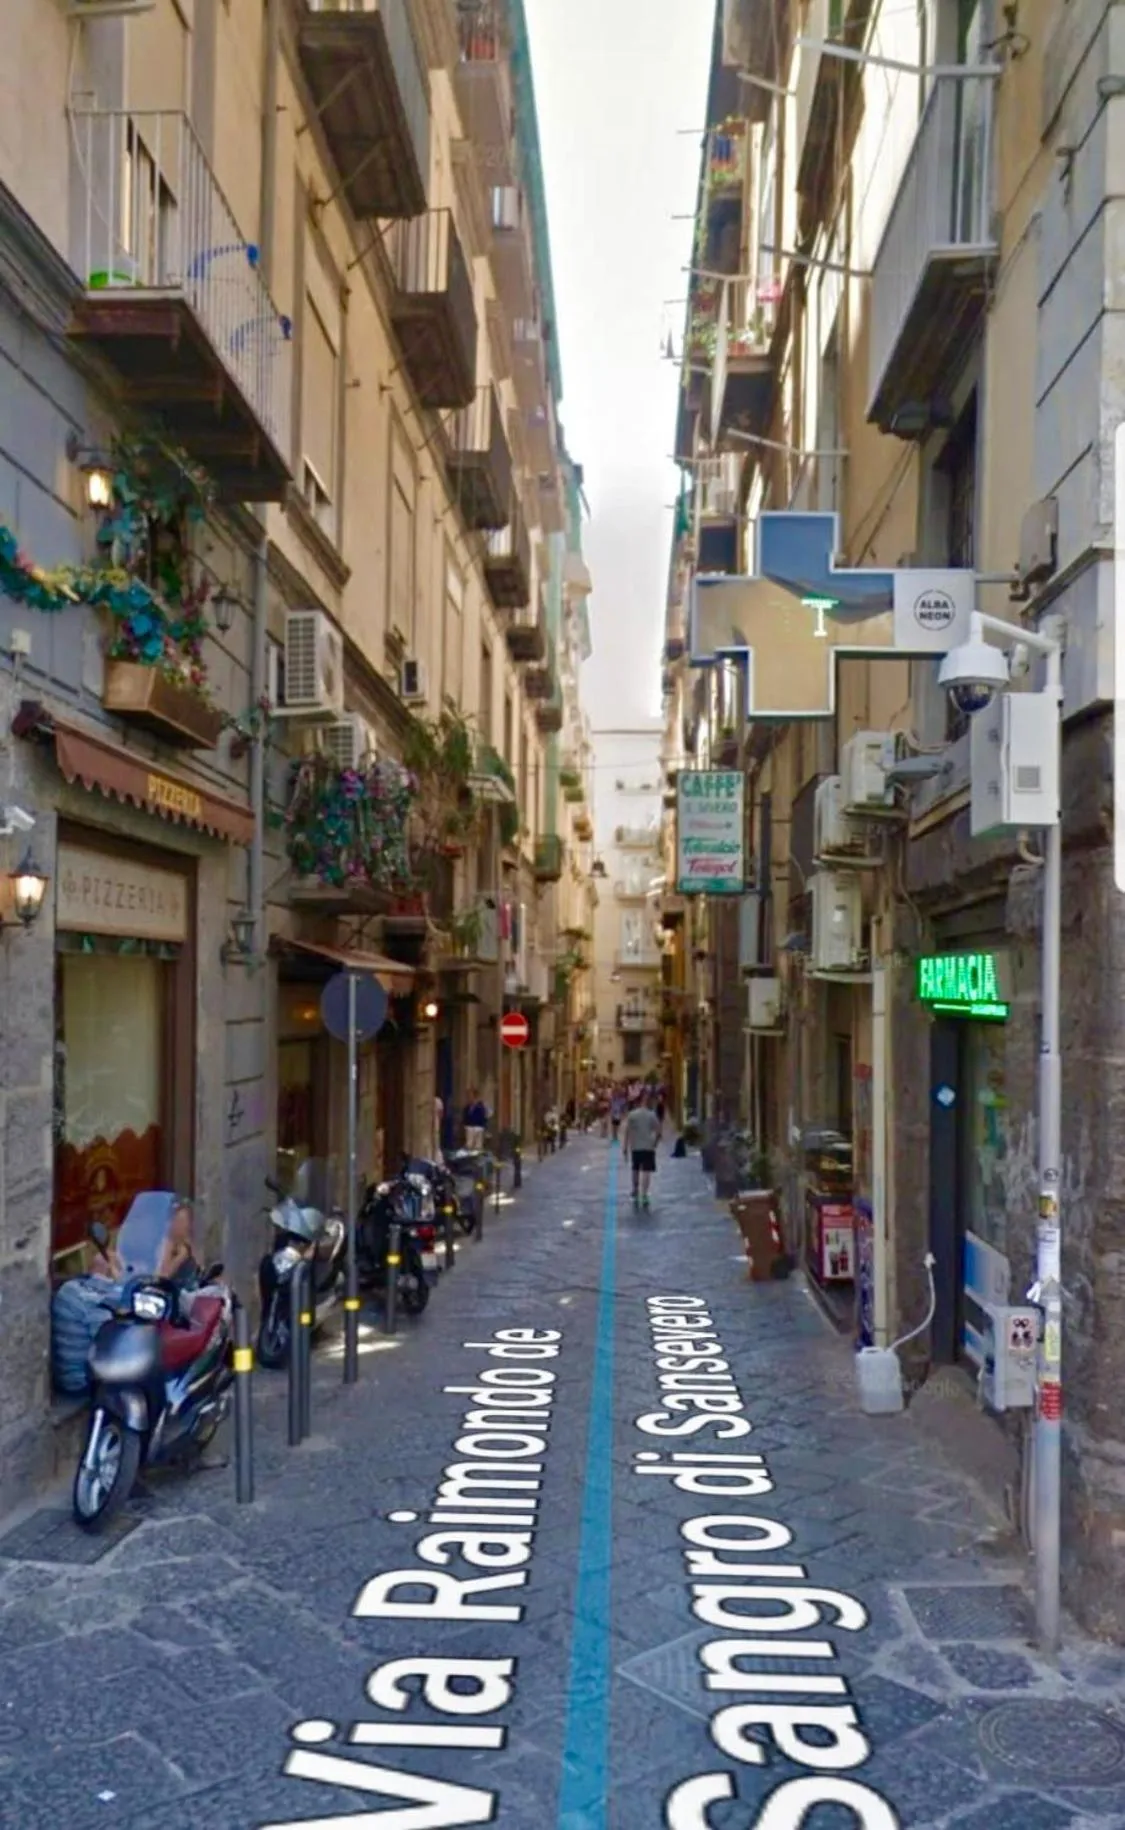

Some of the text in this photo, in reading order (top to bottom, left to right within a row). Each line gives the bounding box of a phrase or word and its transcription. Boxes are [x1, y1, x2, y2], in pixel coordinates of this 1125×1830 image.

[919, 599, 950, 609] ALBA
[919, 611, 951, 621] NEON
[148, 775, 201, 816] PIZZERIA
[82, 875, 166, 914] PIZZERIA
[920, 954, 998, 1002] FARMACIA
